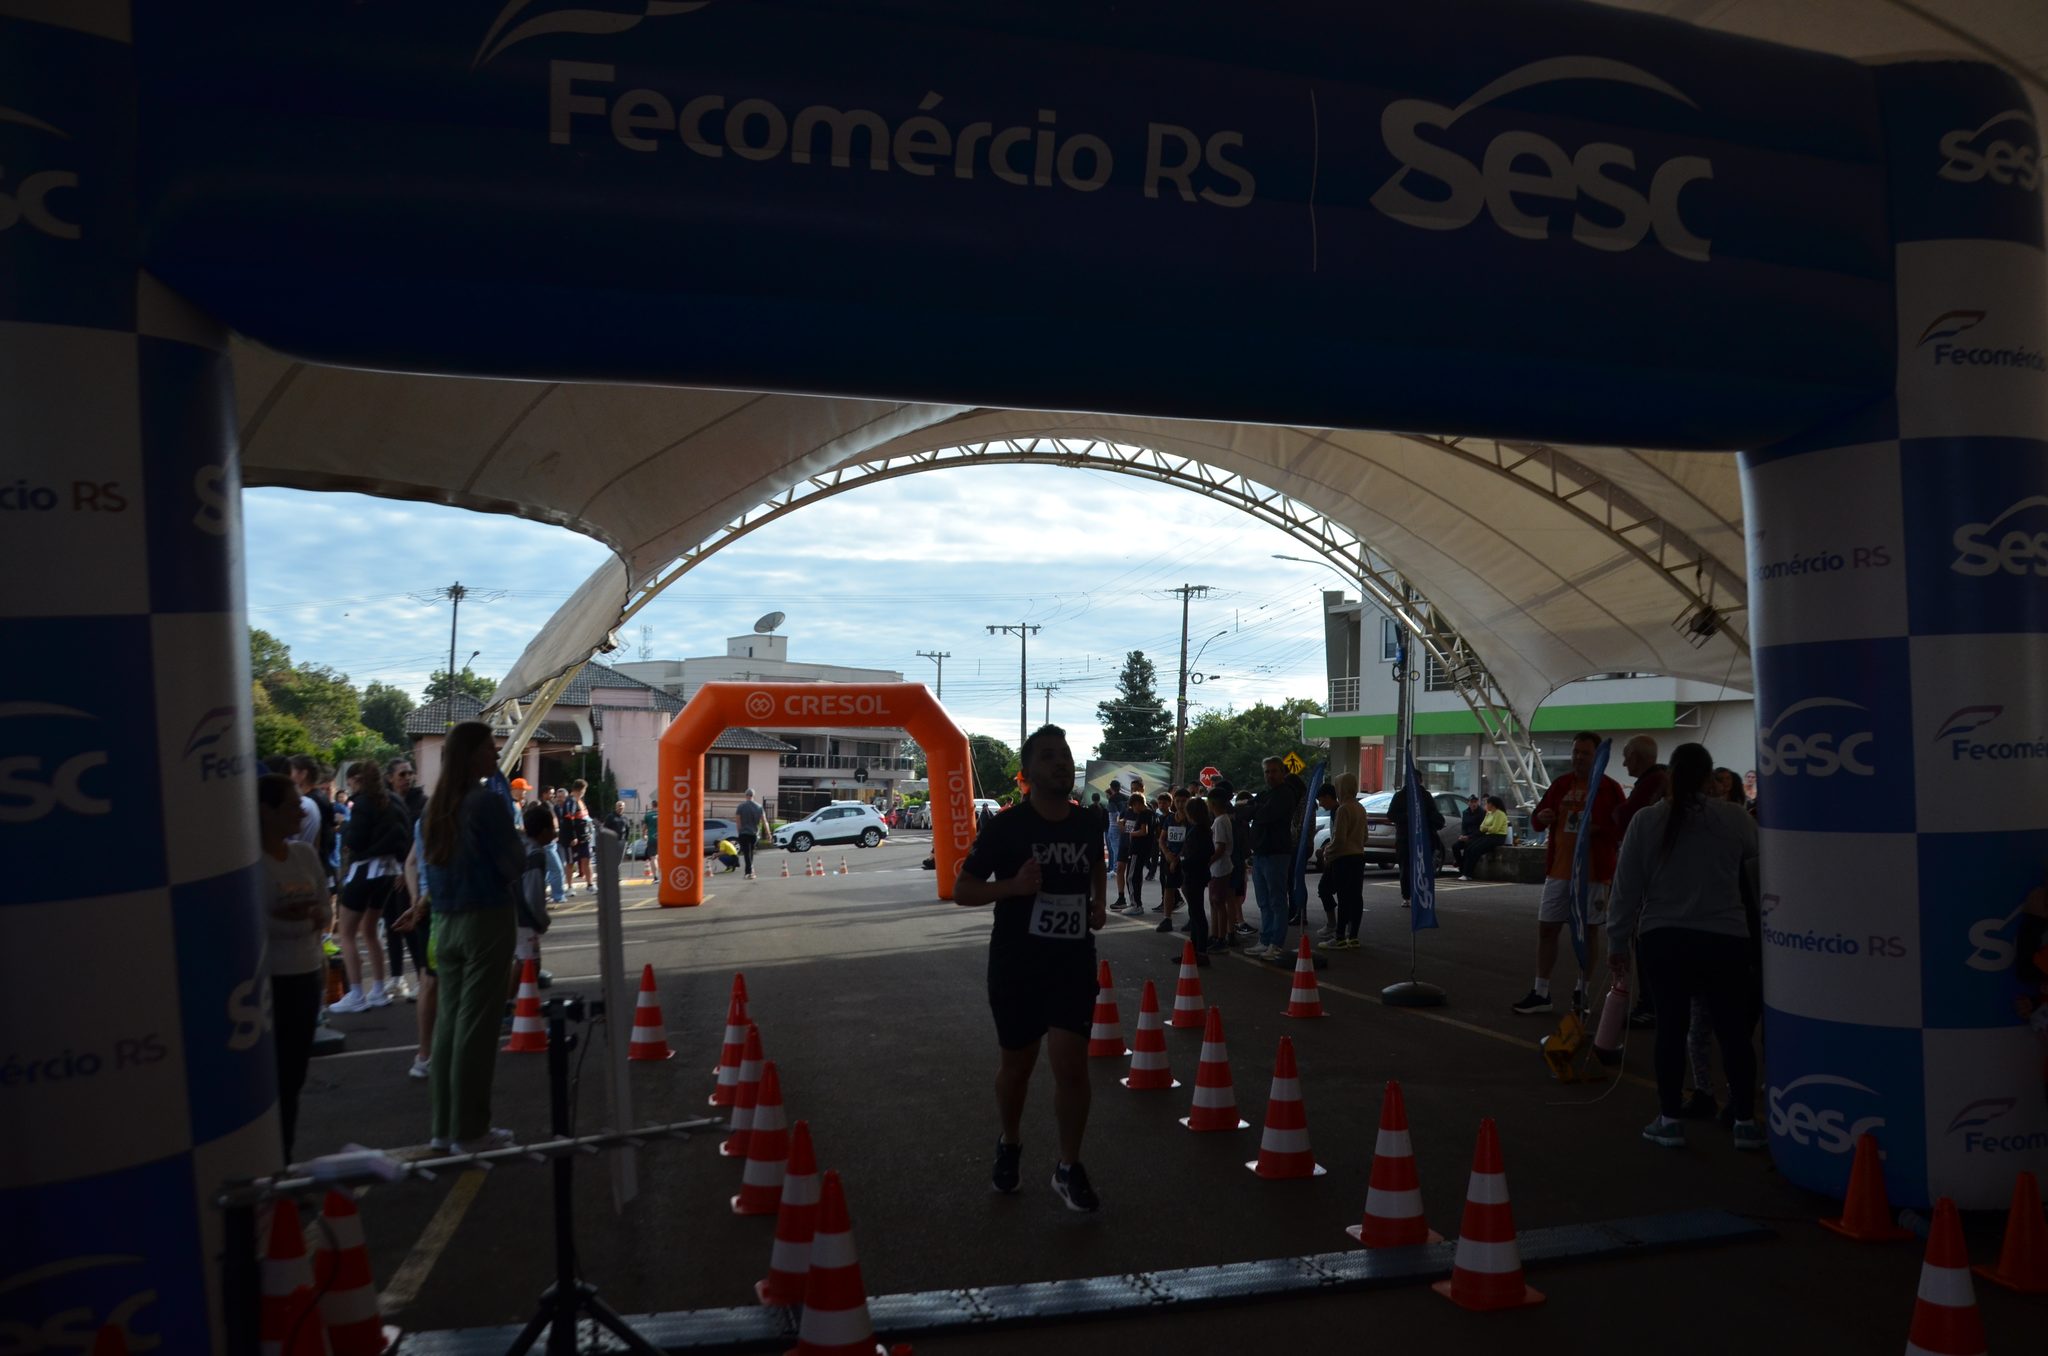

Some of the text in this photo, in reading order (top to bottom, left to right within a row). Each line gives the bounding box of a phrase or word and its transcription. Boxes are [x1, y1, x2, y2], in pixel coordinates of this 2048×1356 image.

[549, 59, 1257, 208] Fecomércio RS
[1369, 98, 1715, 262] Sesc
[72, 480, 129, 513] RS
[1853, 546, 1892, 569] RS
[784, 694, 891, 716] CRESOL
[672, 768, 692, 860] CRESOL
[948, 762, 970, 851] CRESOL
[1038, 909, 1081, 935] 528
[1868, 935, 1907, 958] RS
[115, 1032, 168, 1070] RS
